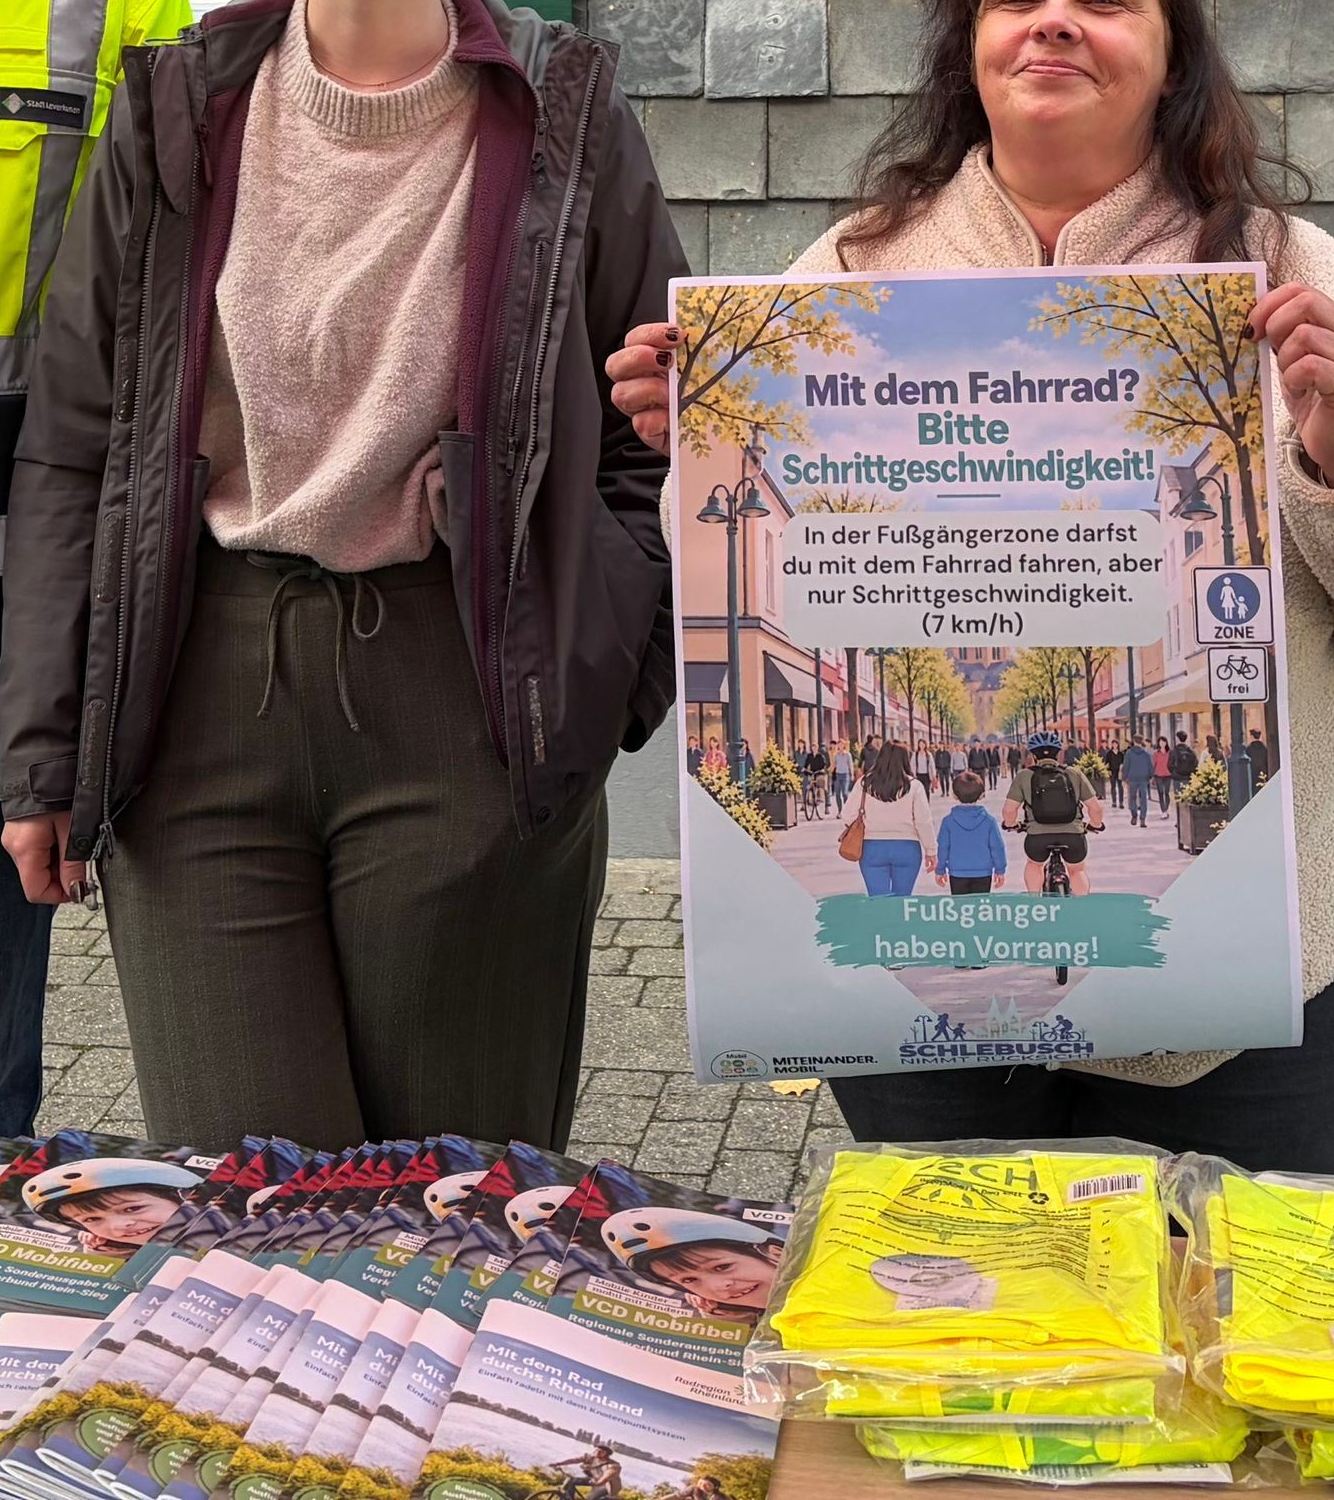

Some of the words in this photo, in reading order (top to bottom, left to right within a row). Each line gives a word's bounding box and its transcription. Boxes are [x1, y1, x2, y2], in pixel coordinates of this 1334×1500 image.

[804, 374, 867, 406] Mit
[875, 372, 959, 405] dem
[969, 369, 1141, 403] Fahrrad?
[918, 412, 1010, 446] Bitte
[782, 449, 1156, 492] Schrittgeschwindigkeit!
[804, 526, 826, 546] In
[831, 525, 871, 546] der
[876, 523, 1060, 550] Fußgängerzone
[1066, 522, 1137, 544] darfst
[782, 555, 813, 576] du
[818, 555, 857, 575] mit
[864, 554, 916, 575] dem
[921, 554, 1012, 575] Fahrrad
[1018, 553, 1103, 578] fahren,
[1108, 553, 1164, 573] aber
[807, 589, 846, 605] nur
[852, 582, 1134, 610] Schrittgeschwindigkeit.
[921, 614, 946, 638] (7
[951, 613, 1024, 638] km/h)
[1214, 626, 1255, 640] ZONE
[1227, 683, 1250, 695] frei
[903, 898, 1061, 928] Fußgänger
[874, 936, 966, 960] haben
[972, 936, 1099, 967] Vorrang!
[772, 1055, 879, 1066] MITEINANDER.
[899, 1042, 1094, 1058] SCHLEBUSCH
[900, 1056, 970, 1065] NIMMT
[774, 1066, 824, 1074] MOBIL.
[195, 1158, 217, 1167] VC
[750, 1211, 786, 1222] VCD
[11, 1247, 114, 1274] Mobifibel
[386, 1248, 414, 1265] VC
[4, 1265, 101, 1289] Sonderausgabe
[39, 1282, 110, 1301] Rhein-Sieg
[187, 1289, 216, 1309] Mit
[263, 1314, 289, 1332] Mi
[582, 1295, 628, 1319] VCD
[633, 1311, 742, 1342] Mobifibel
[317, 1335, 348, 1358] Mit
[568, 1313, 635, 1339] Regionale
[637, 1333, 742, 1358] Sonderausgabe
[375, 1348, 401, 1366] Mi
[486, 1343, 519, 1361] Mit
[522, 1356, 563, 1378] dem
[567, 1371, 604, 1392] Rad
[417, 1358, 446, 1384] Mit
[482, 1356, 544, 1383] durchs
[548, 1376, 644, 1418] Rheinland
[675, 1375, 732, 1396] Radregion
